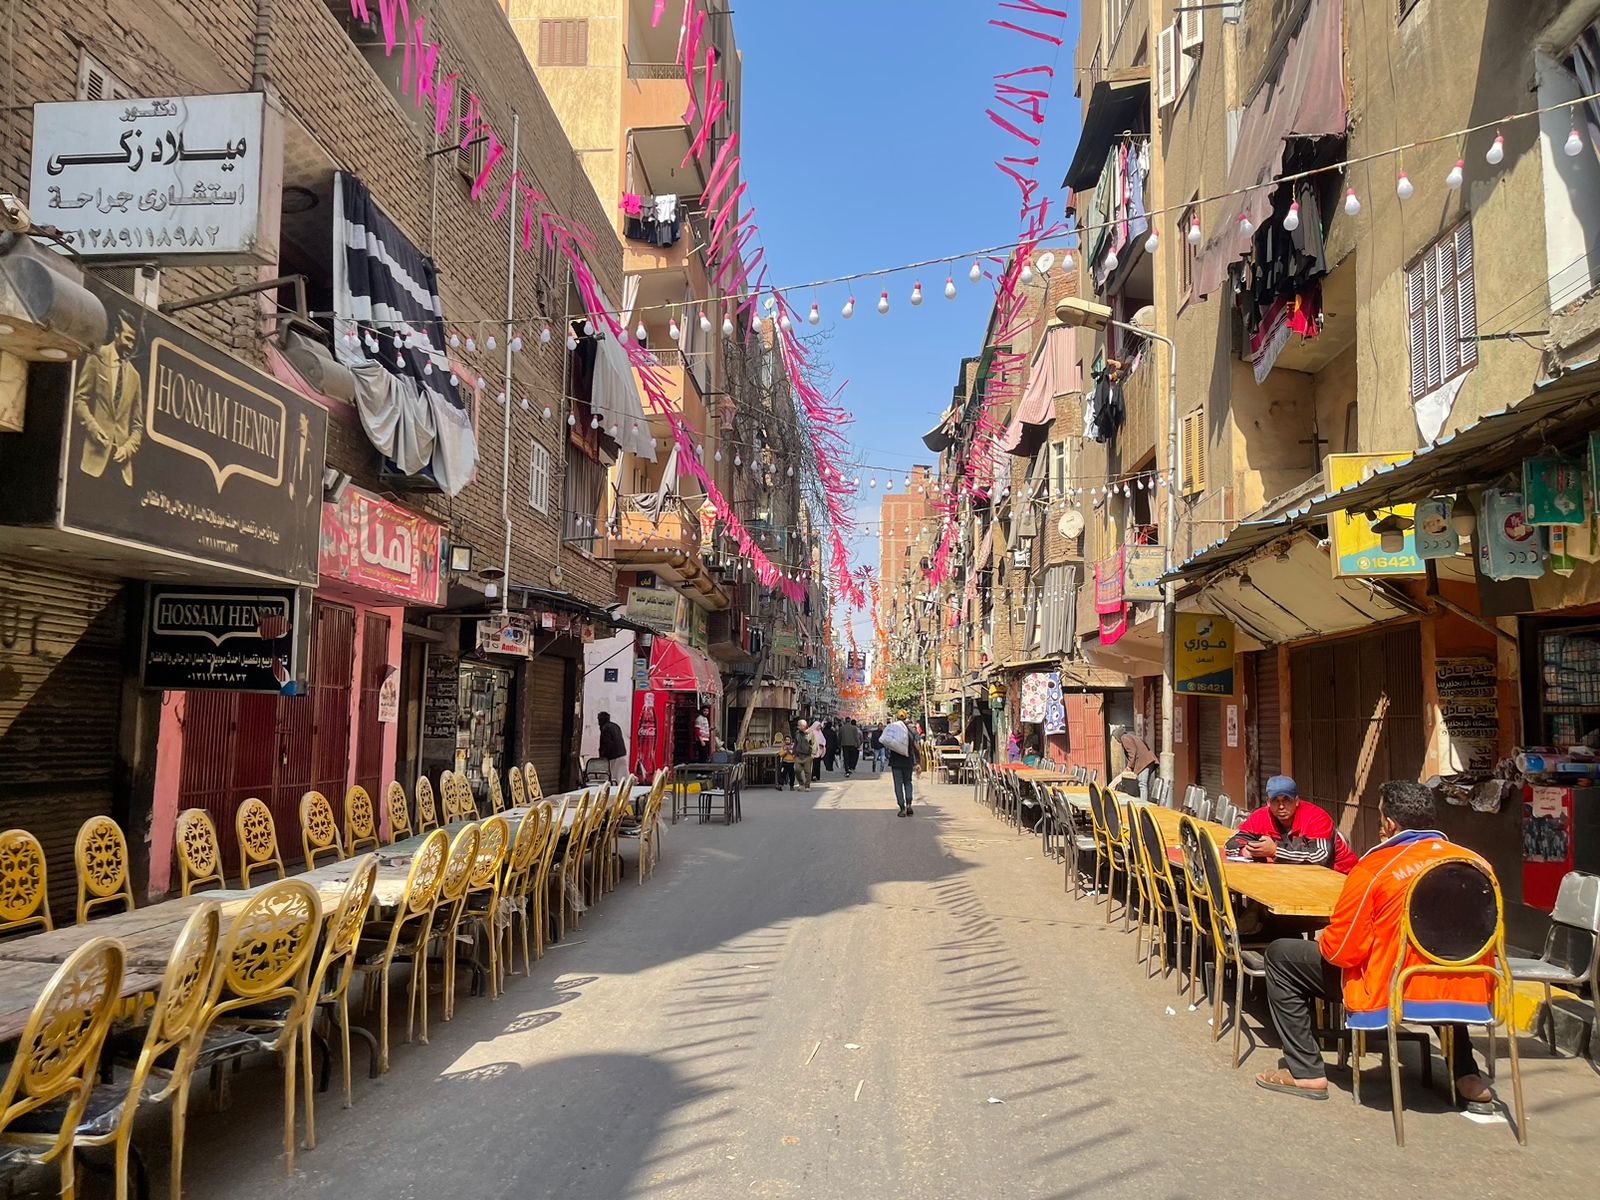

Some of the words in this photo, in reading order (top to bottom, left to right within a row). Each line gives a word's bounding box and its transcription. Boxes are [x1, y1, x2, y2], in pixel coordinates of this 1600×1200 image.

[119, 99, 177, 122] دكتور
[150, 129, 247, 172] ميلاد
[48, 184, 134, 214] جراحة
[157, 364, 229, 439] HOSSAM
[232, 399, 281, 460] HENRY
[1372, 556, 1416, 568] 16421
[160, 603, 225, 626] HOSSAM
[1184, 637, 1227, 652] فوري
